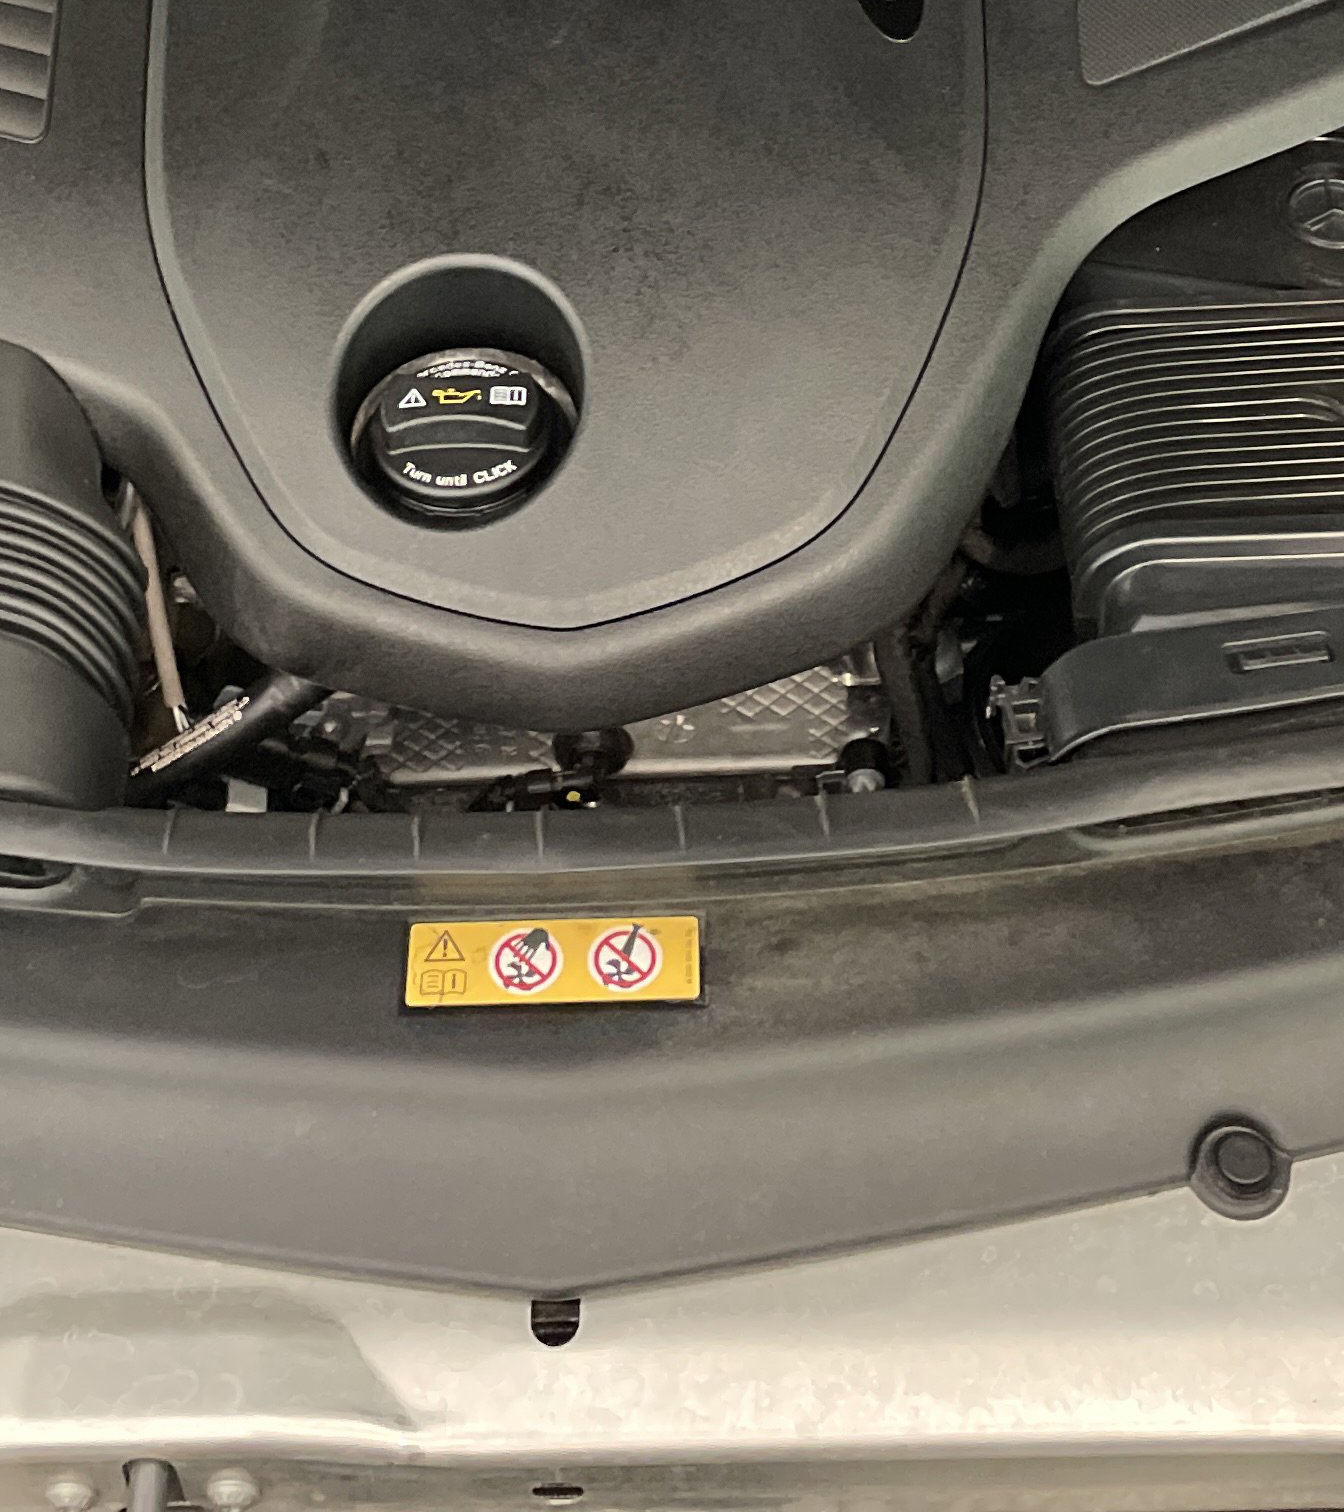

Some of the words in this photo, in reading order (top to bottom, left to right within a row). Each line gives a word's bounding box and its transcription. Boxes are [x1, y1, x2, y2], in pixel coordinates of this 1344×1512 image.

[402, 461, 432, 483] Turn
[435, 473, 468, 487] until
[472, 459, 518, 484] CLICK
